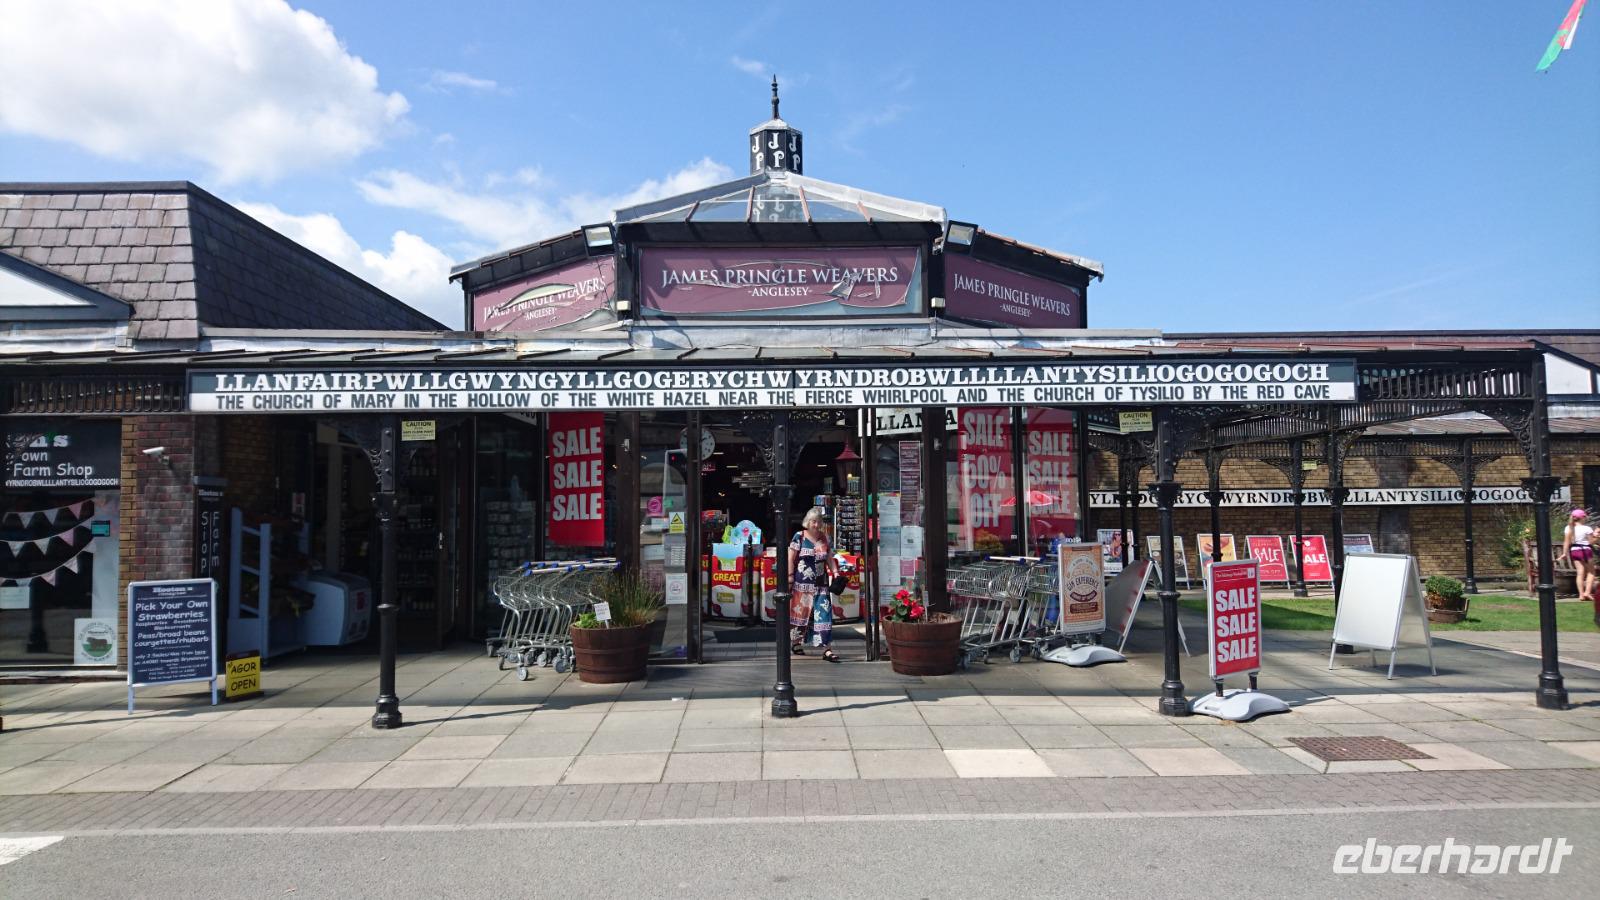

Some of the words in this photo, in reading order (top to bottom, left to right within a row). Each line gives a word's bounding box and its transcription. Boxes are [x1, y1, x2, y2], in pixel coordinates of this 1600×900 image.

[557, 275, 606, 300] WEAVERS
[662, 268, 719, 287] JAMES
[725, 267, 807, 285] PRINGLE
[812, 266, 898, 284] WEAVERS
[953, 273, 986, 295] JAMES
[988, 282, 1030, 306] PRINGLE
[1031, 294, 1071, 317] WEAVERS
[216, 394, 244, 410] THE
[252, 394, 314, 409] CHURCH
[323, 394, 342, 409] OF
[350, 393, 396, 409] MARY
[404, 393, 420, 408] IN
[428, 393, 458, 408] THE
[467, 392, 531, 408] HOLLOW
[540, 392, 560, 407] OF
[568, 392, 597, 407] THE
[607, 391, 655, 407] WHITE
[663, 391, 710, 406] HAZEL
[718, 391, 759, 406] NEAR
[767, 390, 794, 405] THE
[805, 390, 853, 404] FIERCE
[863, 389, 948, 404] WHIRLPOOL
[956, 388, 988, 403] AND
[997, 388, 1025, 403] THE
[1033, 387, 1095, 402] CHURCH
[1104, 387, 1124, 401] OF
[1130, 386, 1185, 401] TYSILIO
[1193, 386, 1212, 400] BY
[1221, 386, 1248, 400] THE
[1257, 385, 1285, 400] RED
[1294, 385, 1330, 400] CAVE
[553, 426, 602, 458] SALE
[964, 411, 1004, 447] SALE
[1029, 430, 1070, 457] SALE
[13, 463, 51, 477] Farm
[56, 462, 93, 479] Shop
[553, 460, 603, 490] SALE
[1029, 459, 1070, 485] SALE
[553, 492, 602, 522] SALE
[969, 492, 1003, 529] OFF
[1029, 488, 1071, 515] SALE
[1254, 547, 1281, 563] SALE
[713, 573, 742, 582] GREAT
[135, 602, 156, 612] Pick
[159, 601, 183, 610] Your
[186, 600, 208, 609] Own
[1215, 586, 1256, 612] SALE
[138, 610, 204, 622] Strawberries
[1216, 611, 1256, 637] SALE
[1217, 636, 1257, 663] SALE
[230, 661, 257, 675] AGOR
[231, 677, 257, 691] OPEN
